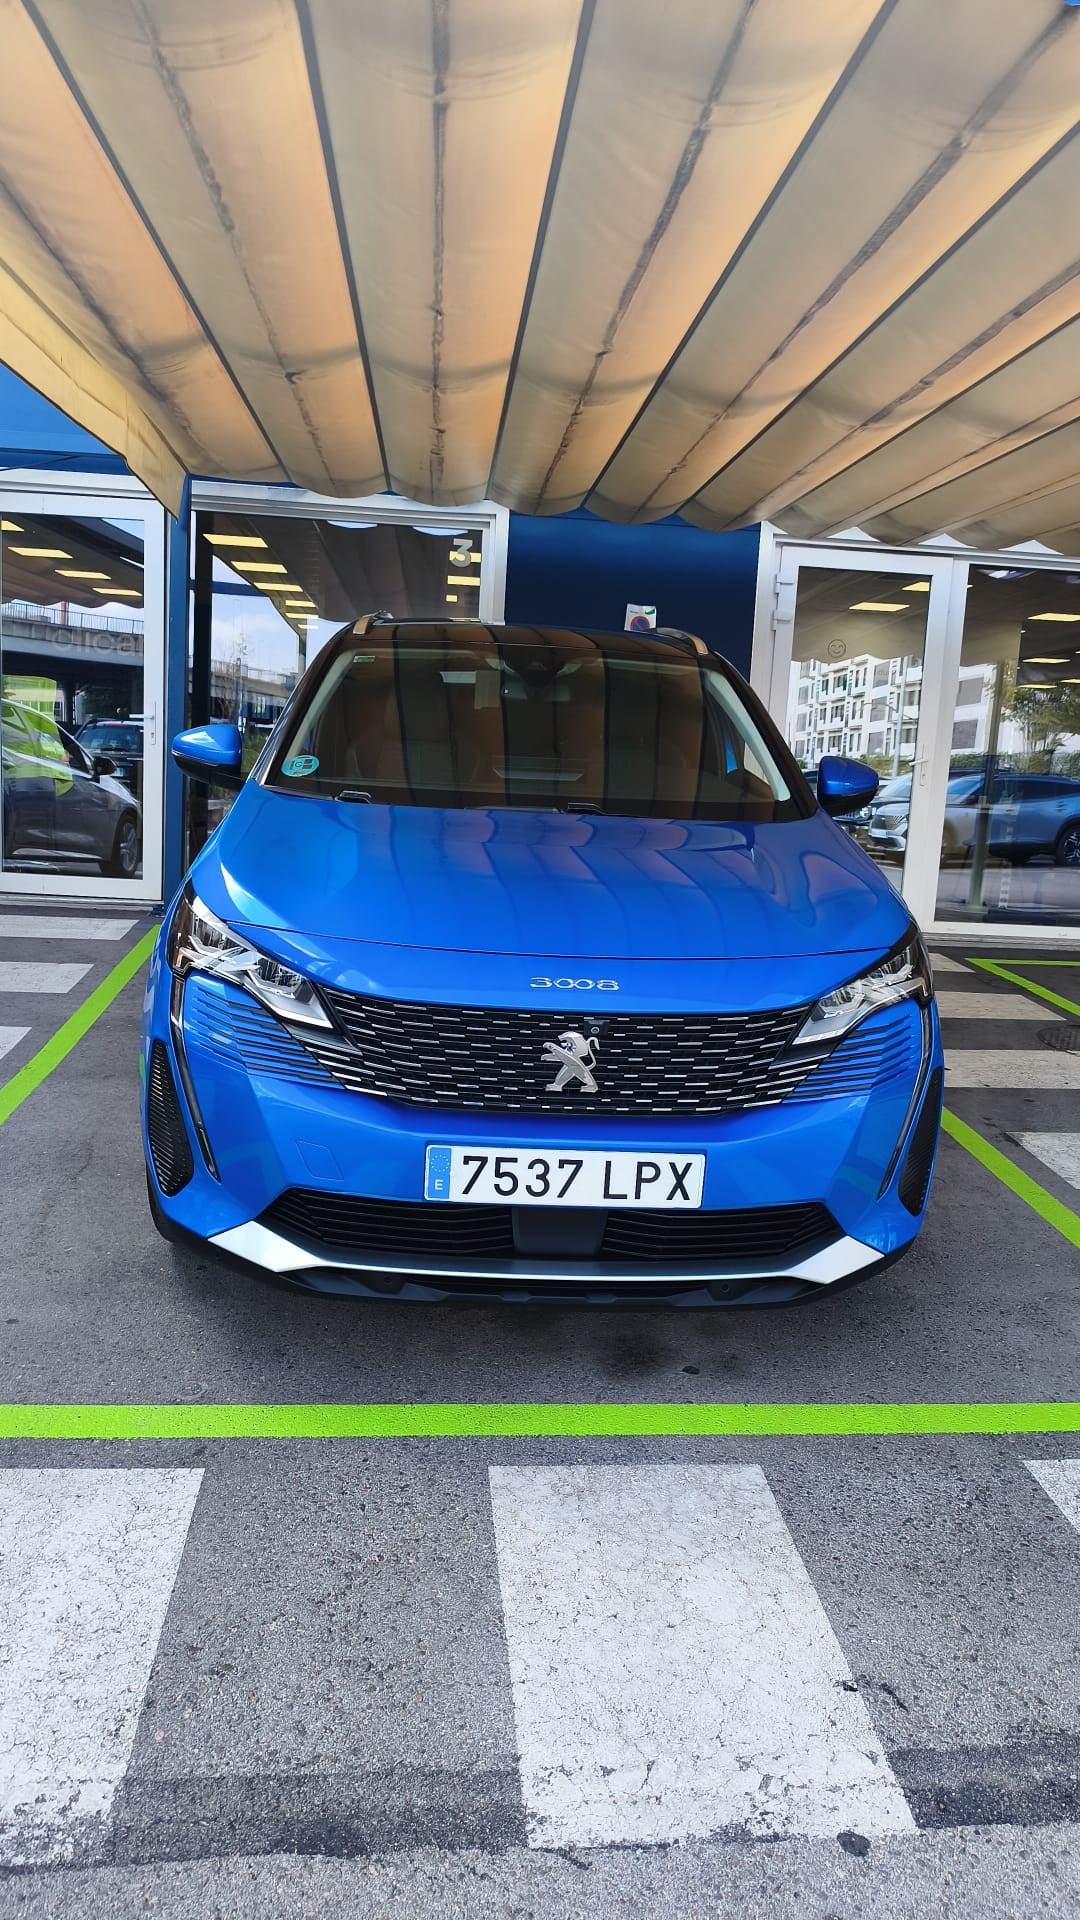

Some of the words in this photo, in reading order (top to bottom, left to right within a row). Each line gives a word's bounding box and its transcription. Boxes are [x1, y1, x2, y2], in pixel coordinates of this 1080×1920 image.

[450, 538, 473, 568] 3
[529, 977, 620, 991] 3008
[434, 1179, 444, 1191] E
[461, 1155, 584, 1199] 7537
[603, 1160, 694, 1201] LPX
